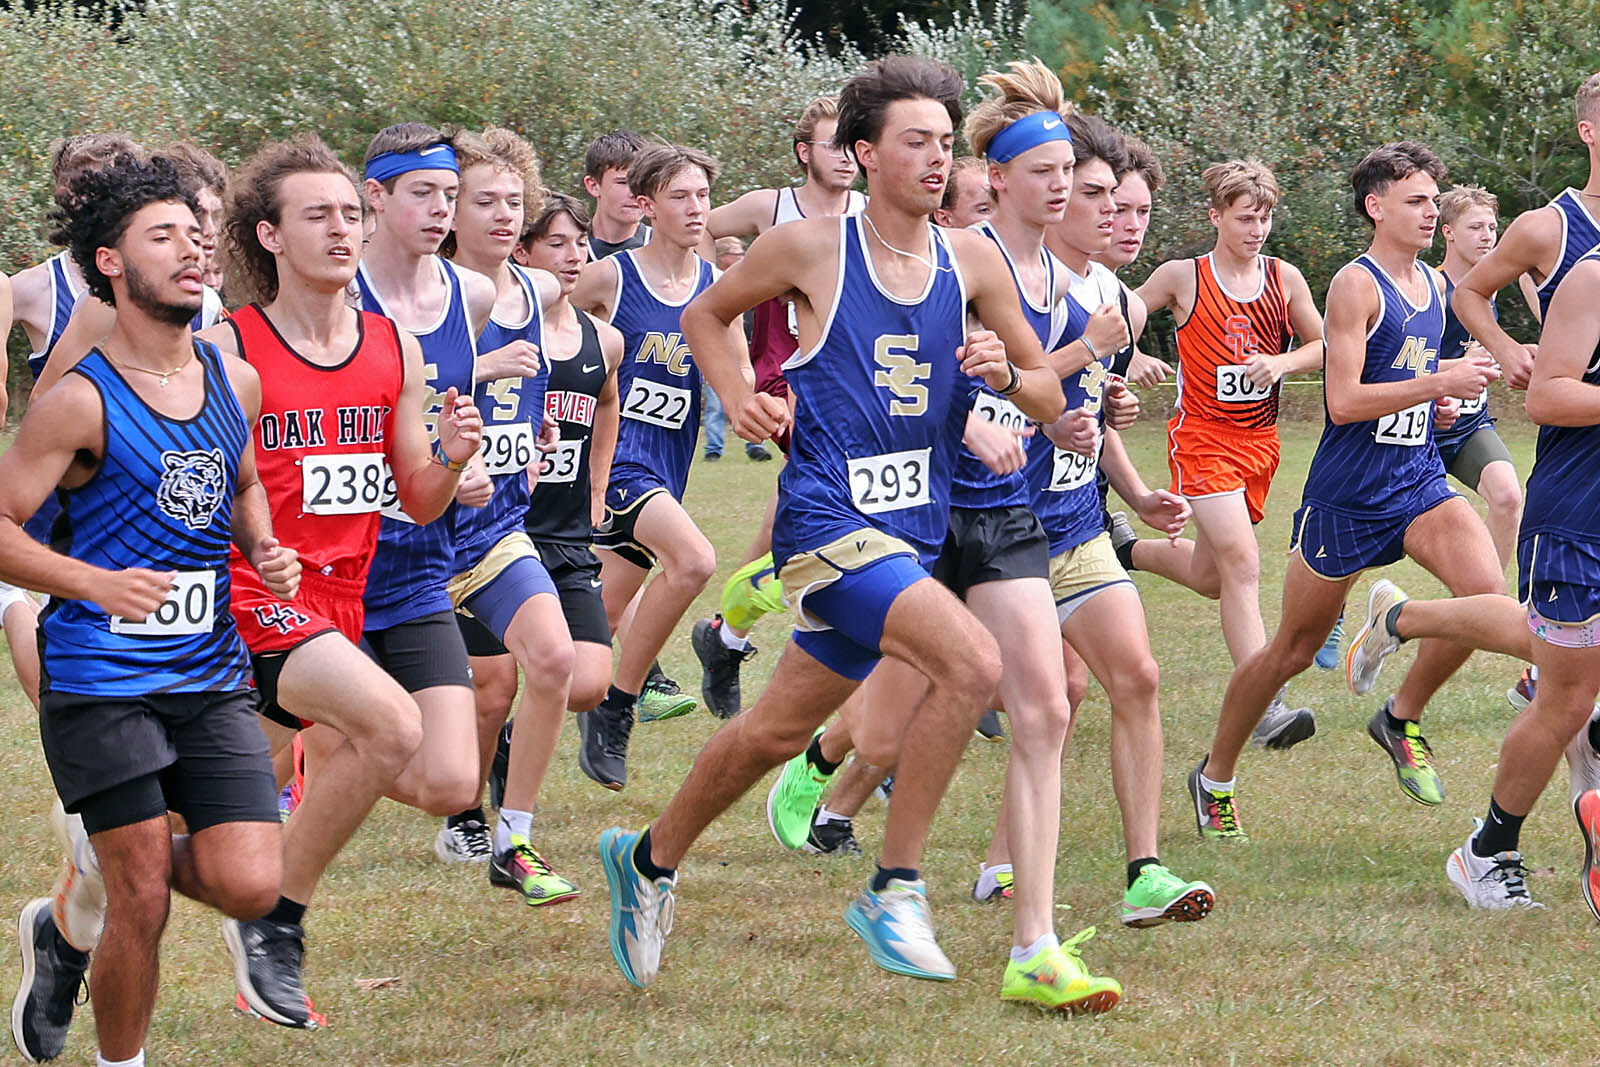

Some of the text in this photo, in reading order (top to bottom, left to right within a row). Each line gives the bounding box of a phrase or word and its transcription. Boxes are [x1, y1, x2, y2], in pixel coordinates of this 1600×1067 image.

[635, 332, 693, 376] NC
[1391, 336, 1437, 379] NC
[627, 387, 686, 423] 222
[1381, 411, 1426, 439] 219
[260, 406, 391, 451] OAK HIL
[481, 433, 530, 468] 296
[310, 464, 380, 506] 238
[854, 460, 922, 505] 293
[119, 583, 208, 626] 60
